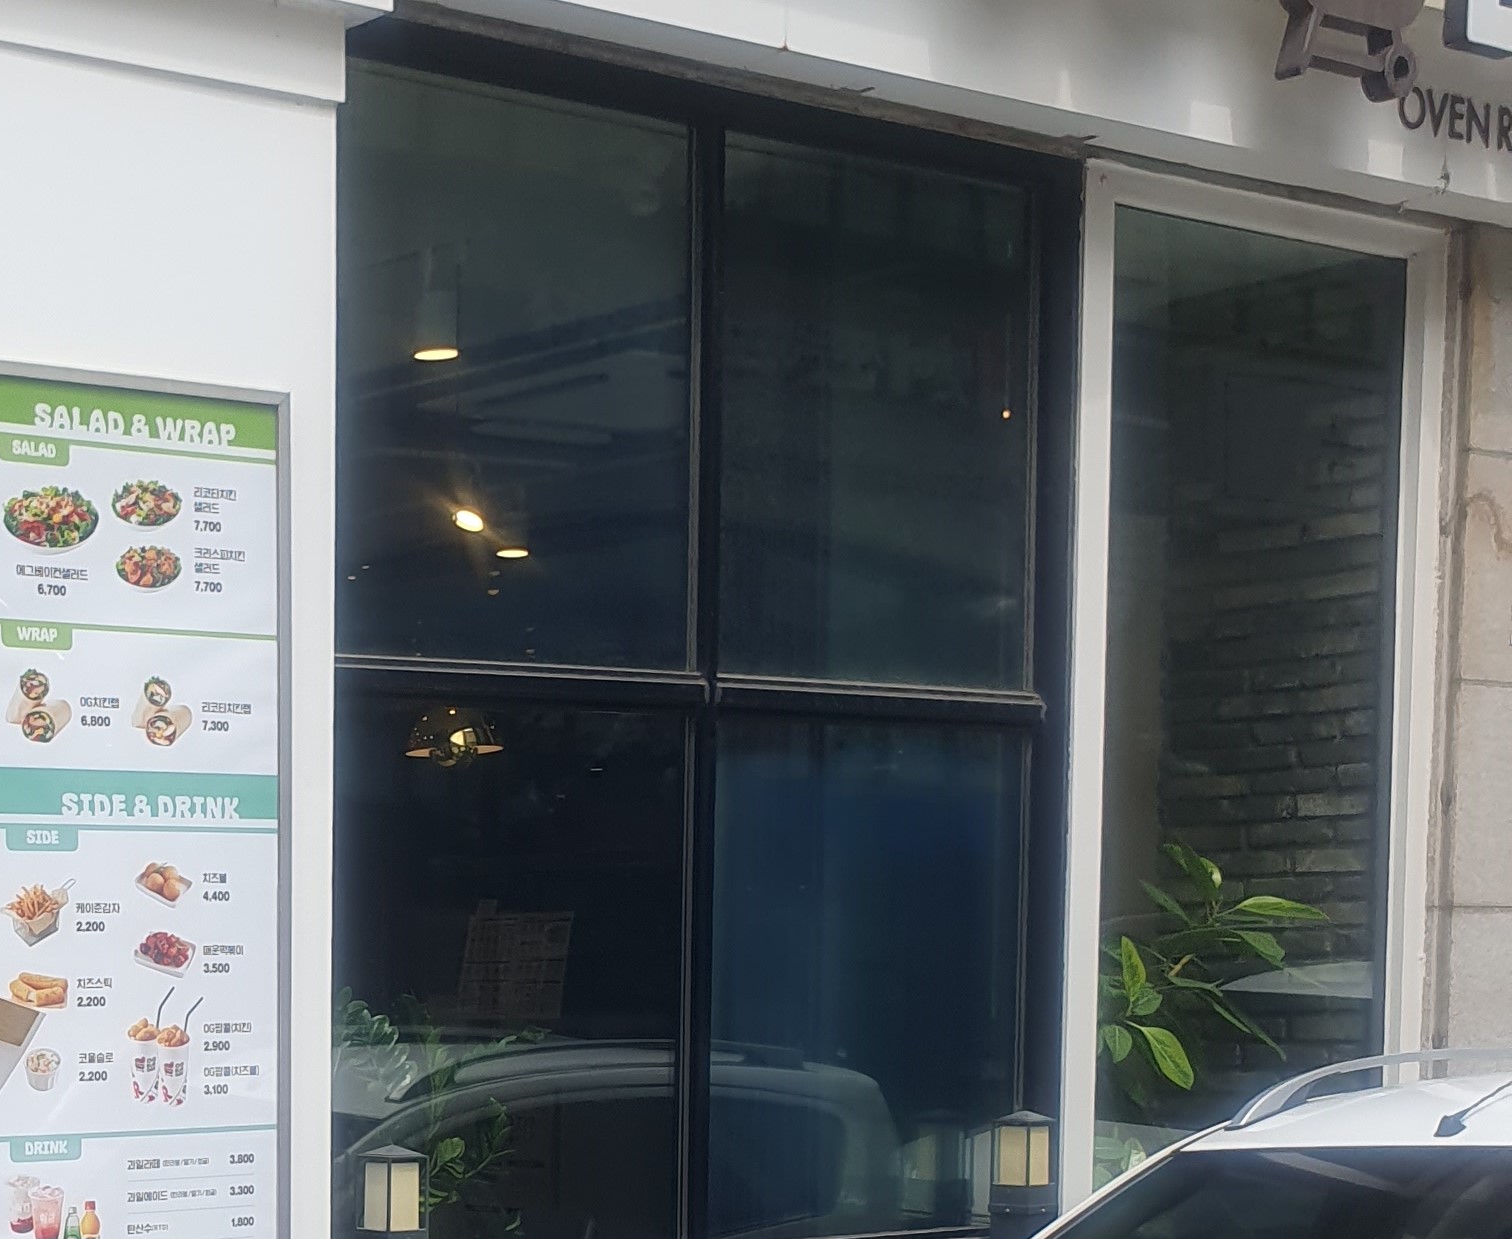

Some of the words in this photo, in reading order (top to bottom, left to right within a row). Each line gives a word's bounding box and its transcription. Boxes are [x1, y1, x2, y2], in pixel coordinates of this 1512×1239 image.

[1398, 86, 1491, 150] OVEN
[34, 403, 125, 436] SALAD
[131, 414, 149, 438] &
[155, 417, 236, 447] WRAP
[12, 440, 56, 458] SALAD
[194, 520, 221, 532] 7,700
[37, 584, 66, 596] 6,700
[195, 581, 222, 592] 7,700
[17, 627, 57, 642] WRAP
[81, 716, 110, 727] 6,800
[202, 721, 229, 732] 7,300
[62, 793, 126, 817] SIDE
[133, 795, 151, 818] &
[158, 796, 239, 820] DRINK
[26, 830, 59, 844] SIDE
[203, 891, 230, 901] 4,400
[76, 922, 105, 932] 2,200
[203, 963, 230, 973] 3,500
[77, 978, 112, 989] 치즈스틱
[77, 997, 106, 1007] 2,200
[79, 1071, 107, 1081] 2,200
[204, 1084, 228, 1094] 3,100
[25, 1140, 68, 1156] DRINK
[229, 1154, 254, 1164] 3,800
[229, 1185, 254, 1195] 3,300
